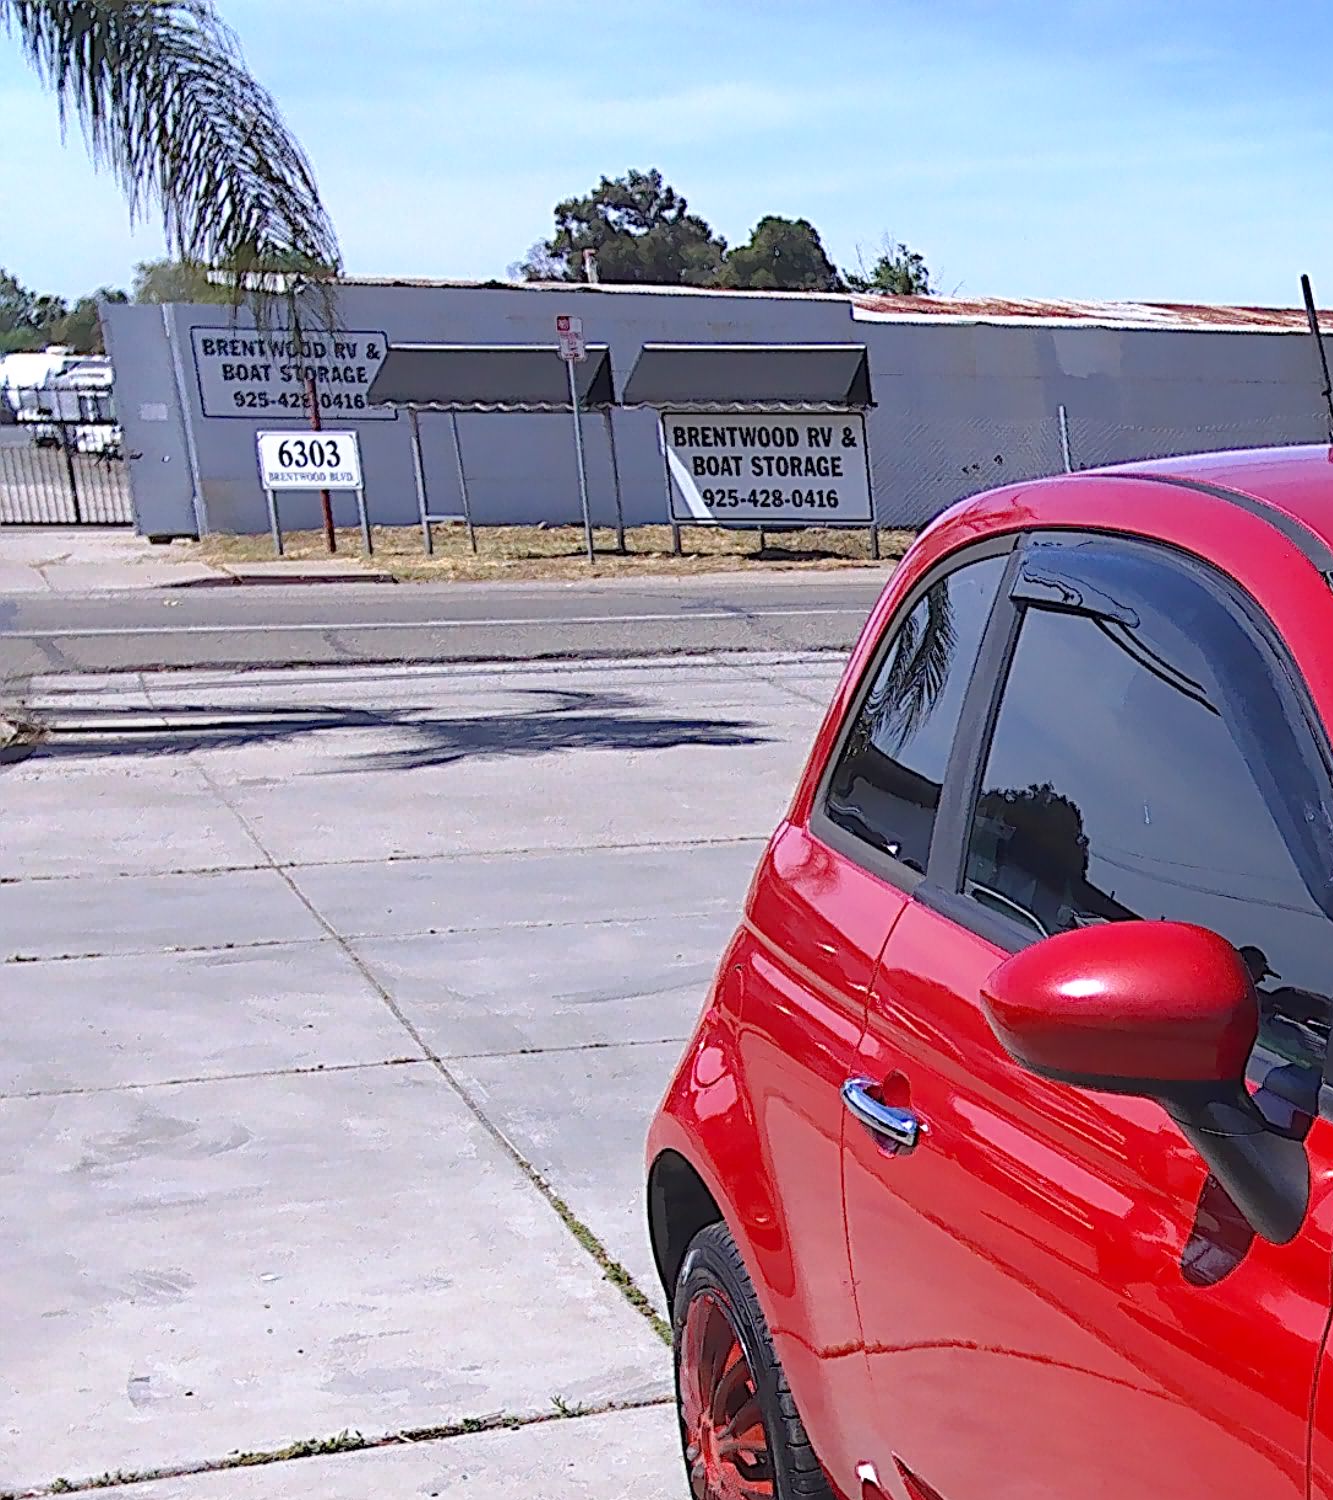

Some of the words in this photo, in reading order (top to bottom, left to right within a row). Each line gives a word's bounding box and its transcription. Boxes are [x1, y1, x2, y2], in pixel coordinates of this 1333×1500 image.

[202, 338, 327, 359] BRENTWOOD
[334, 342, 358, 360] RV
[366, 343, 381, 360] &
[222, 363, 272, 382] BOAT
[280, 365, 368, 384] STORAGE
[233, 391, 366, 409] 925-4280416
[673, 426, 800, 448] BRENTWOOD
[807, 427, 833, 448] RV
[841, 427, 857, 448] &
[278, 440, 341, 468] 6303
[268, 471, 326, 482] BRENTWOOD
[692, 456, 743, 476] BOAT
[751, 456, 844, 477] STORAGE
[703, 489, 839, 508] 925-428-0416
